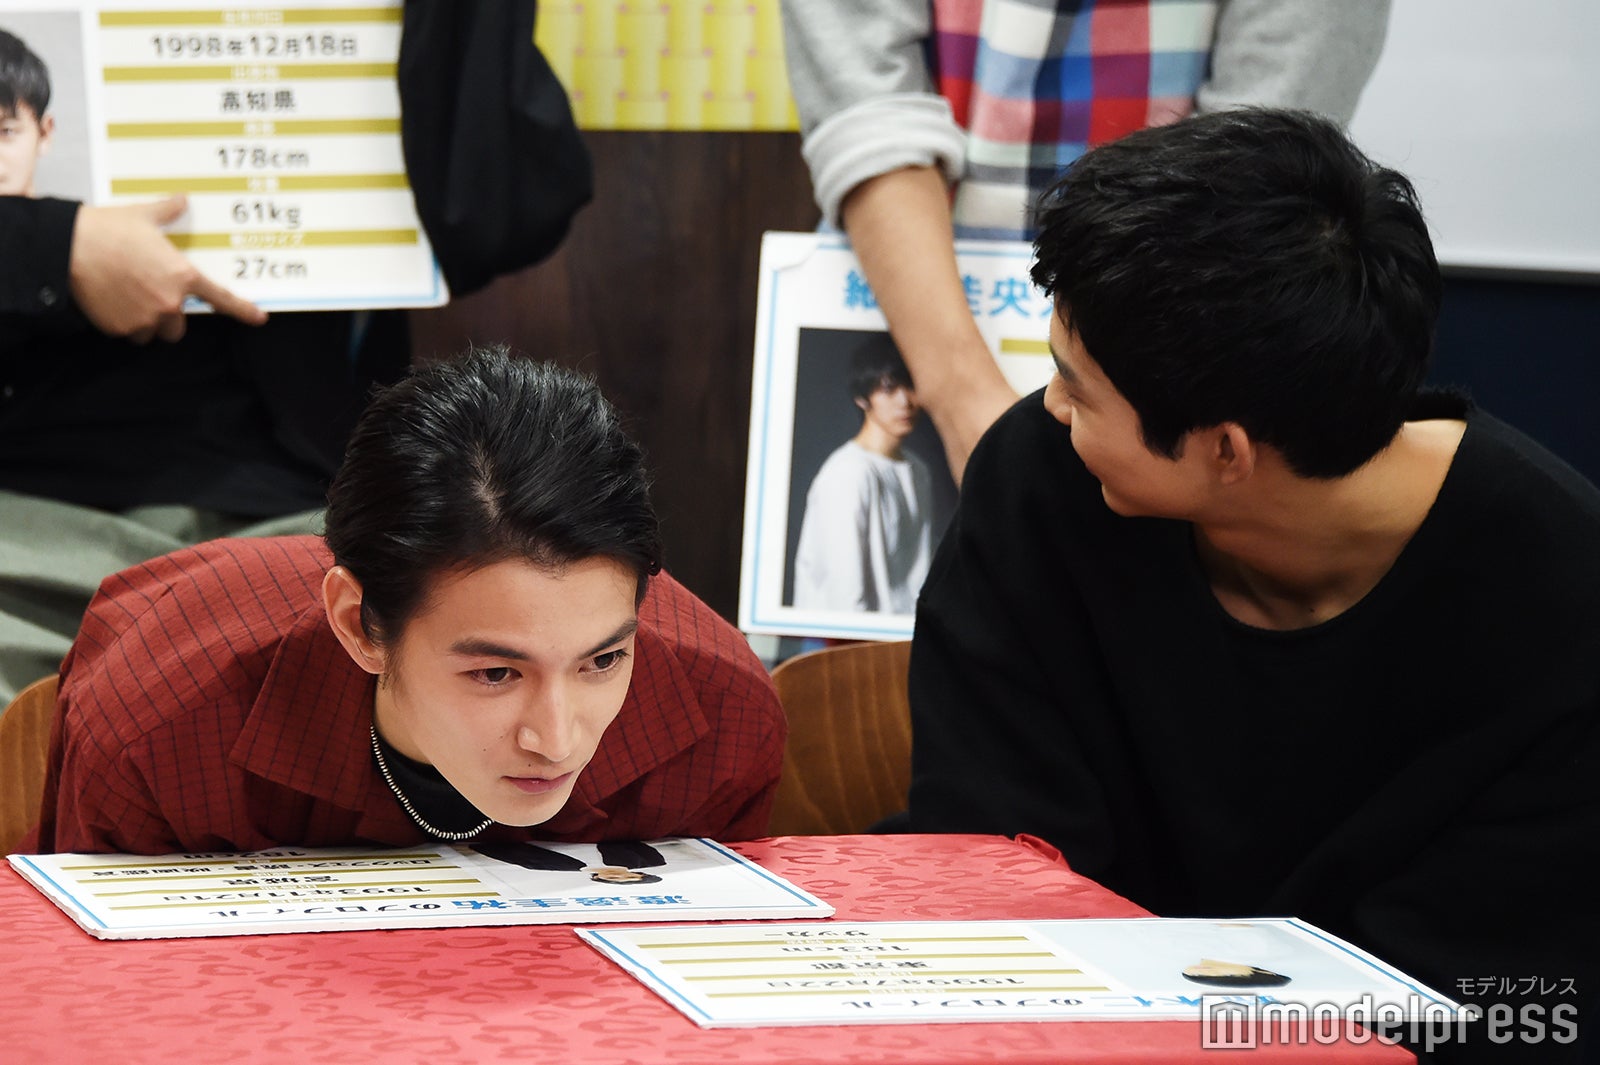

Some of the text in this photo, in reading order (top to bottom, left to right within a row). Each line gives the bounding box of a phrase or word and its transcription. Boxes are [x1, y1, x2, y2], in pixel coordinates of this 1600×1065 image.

[153, 34, 357, 57] 1998年12月18日
[223, 89, 295, 111] 高知県
[217, 147, 309, 168] 178cm
[231, 200, 302, 228] 61kg
[234, 256, 308, 280] 27cm
[163, 887, 431, 901] 1993年11月21日
[209, 903, 441, 918] のプロフィール
[764, 930, 869, 938] サッカー
[782, 944, 910, 953] 183cm
[811, 960, 931, 970] 東京都
[766, 977, 1025, 988] 1999年7月22日
[842, 998, 1083, 1009] のプロフィール
